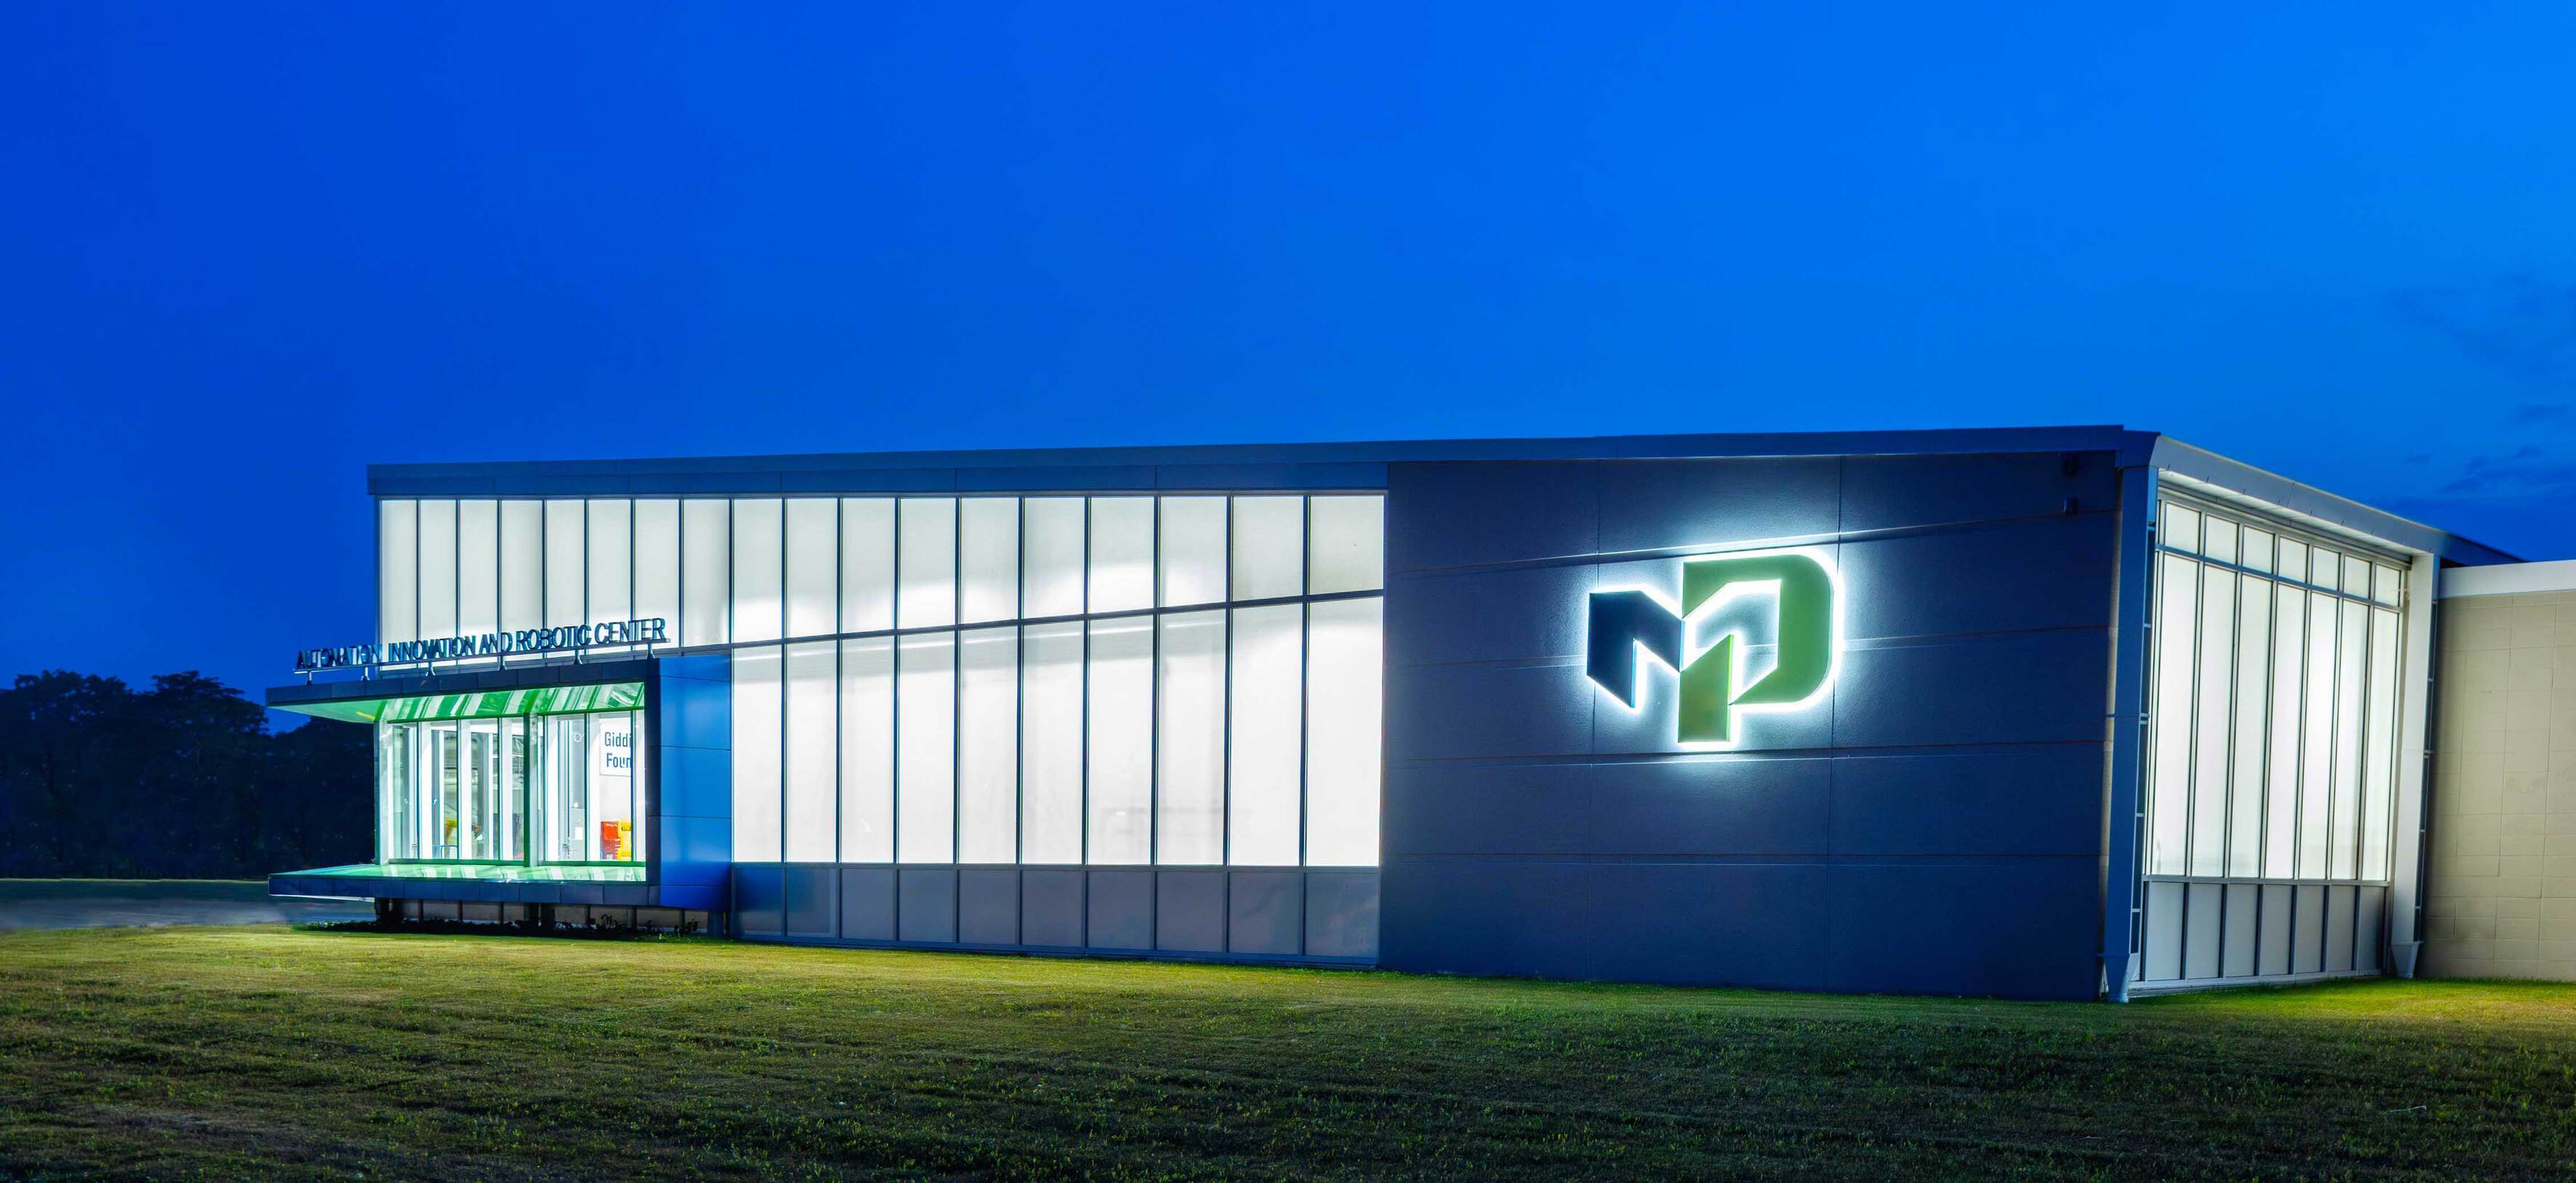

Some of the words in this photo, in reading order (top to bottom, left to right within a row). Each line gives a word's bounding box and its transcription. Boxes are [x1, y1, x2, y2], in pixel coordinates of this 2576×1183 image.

[297, 645, 383, 669] AUTOMATION
[388, 636, 476, 661] INNOVATION
[479, 632, 513, 654] AND
[516, 624, 592, 651] ROBOTIC
[595, 618, 666, 644] CENTER
